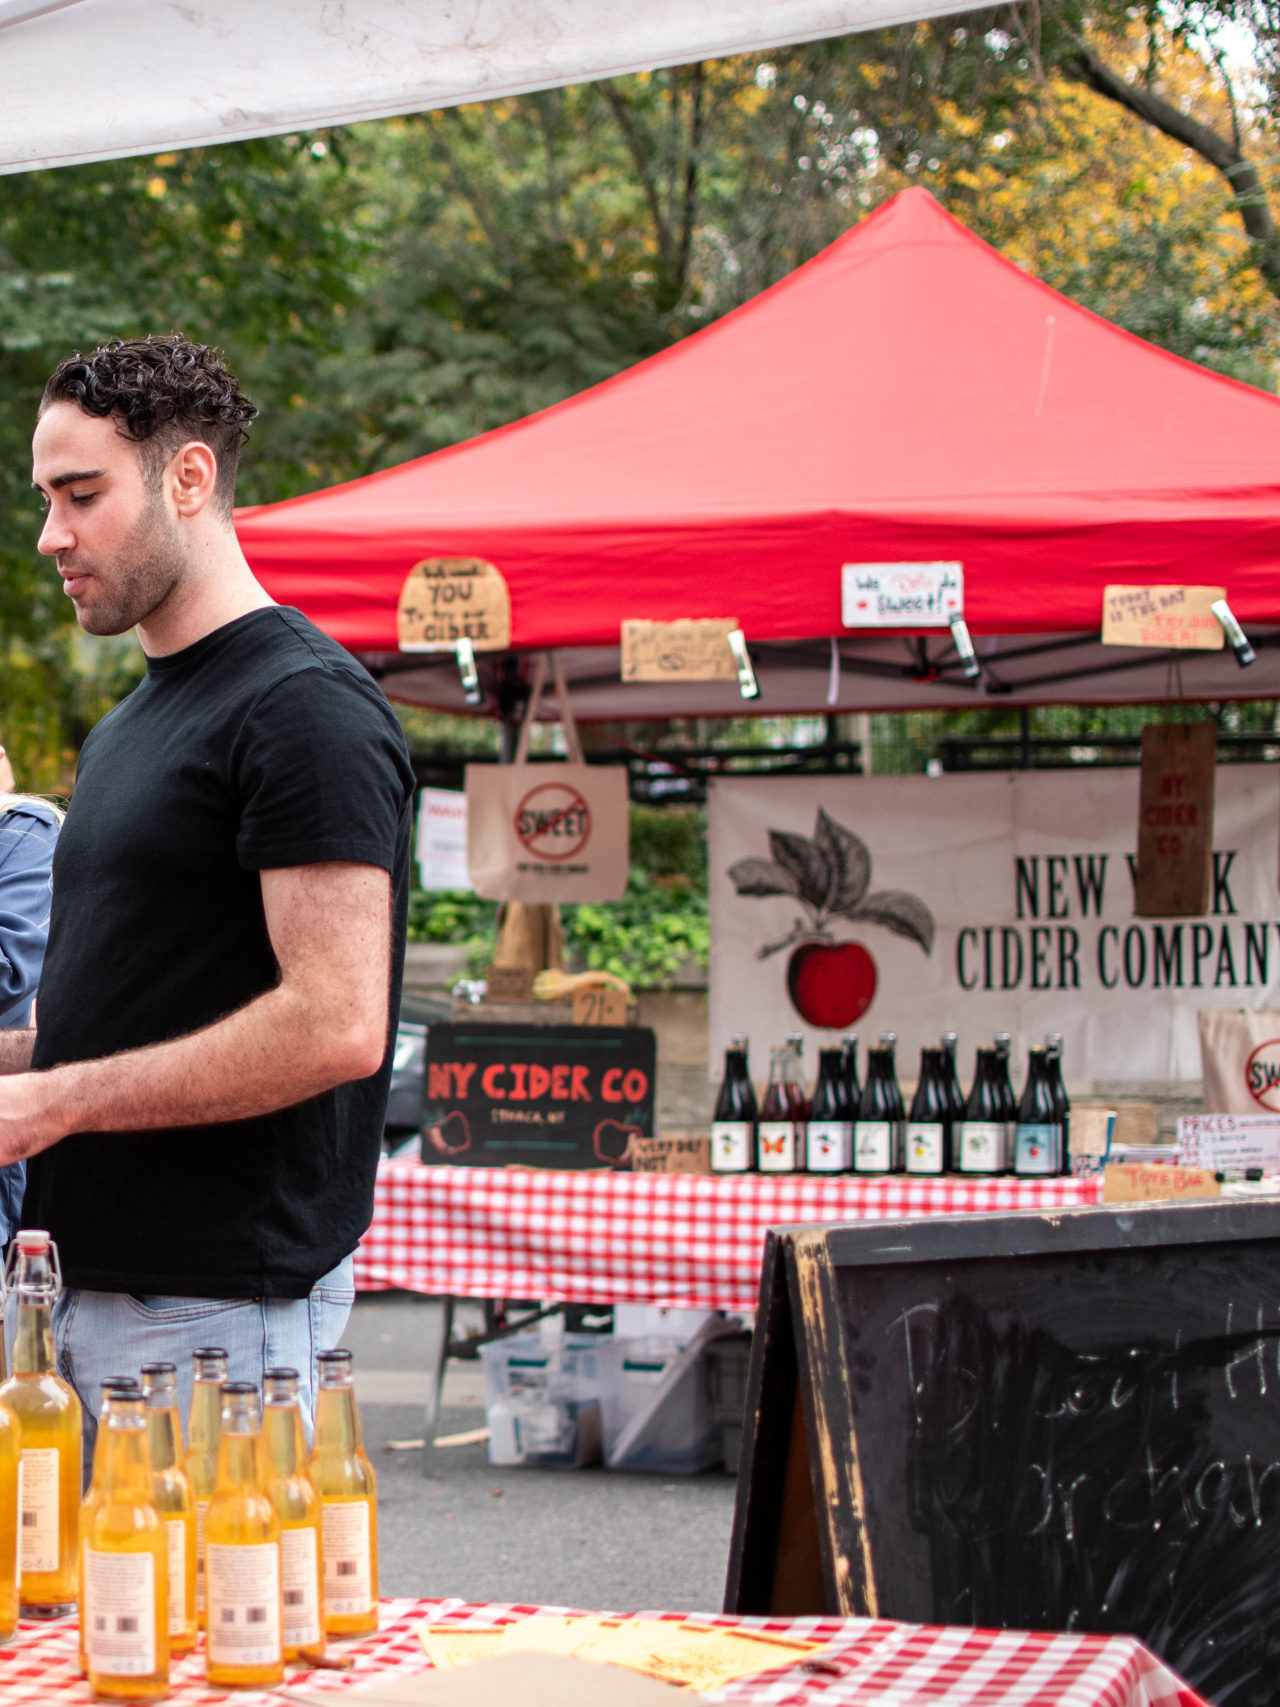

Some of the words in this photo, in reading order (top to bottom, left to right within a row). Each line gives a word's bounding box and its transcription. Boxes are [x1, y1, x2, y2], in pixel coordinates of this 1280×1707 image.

[426, 580, 473, 605] YOU
[423, 622, 488, 642] CIDER
[1161, 774, 1185, 798] NY
[519, 807, 588, 836] SWEET
[1144, 804, 1198, 828] CIDER
[1157, 833, 1182, 856] CO
[1015, 854, 1109, 919] NEW
[956, 926, 1080, 991] CIDER
[428, 1062, 477, 1099] NY
[481, 1063, 592, 1102] CIDER
[601, 1068, 648, 1103] CO
